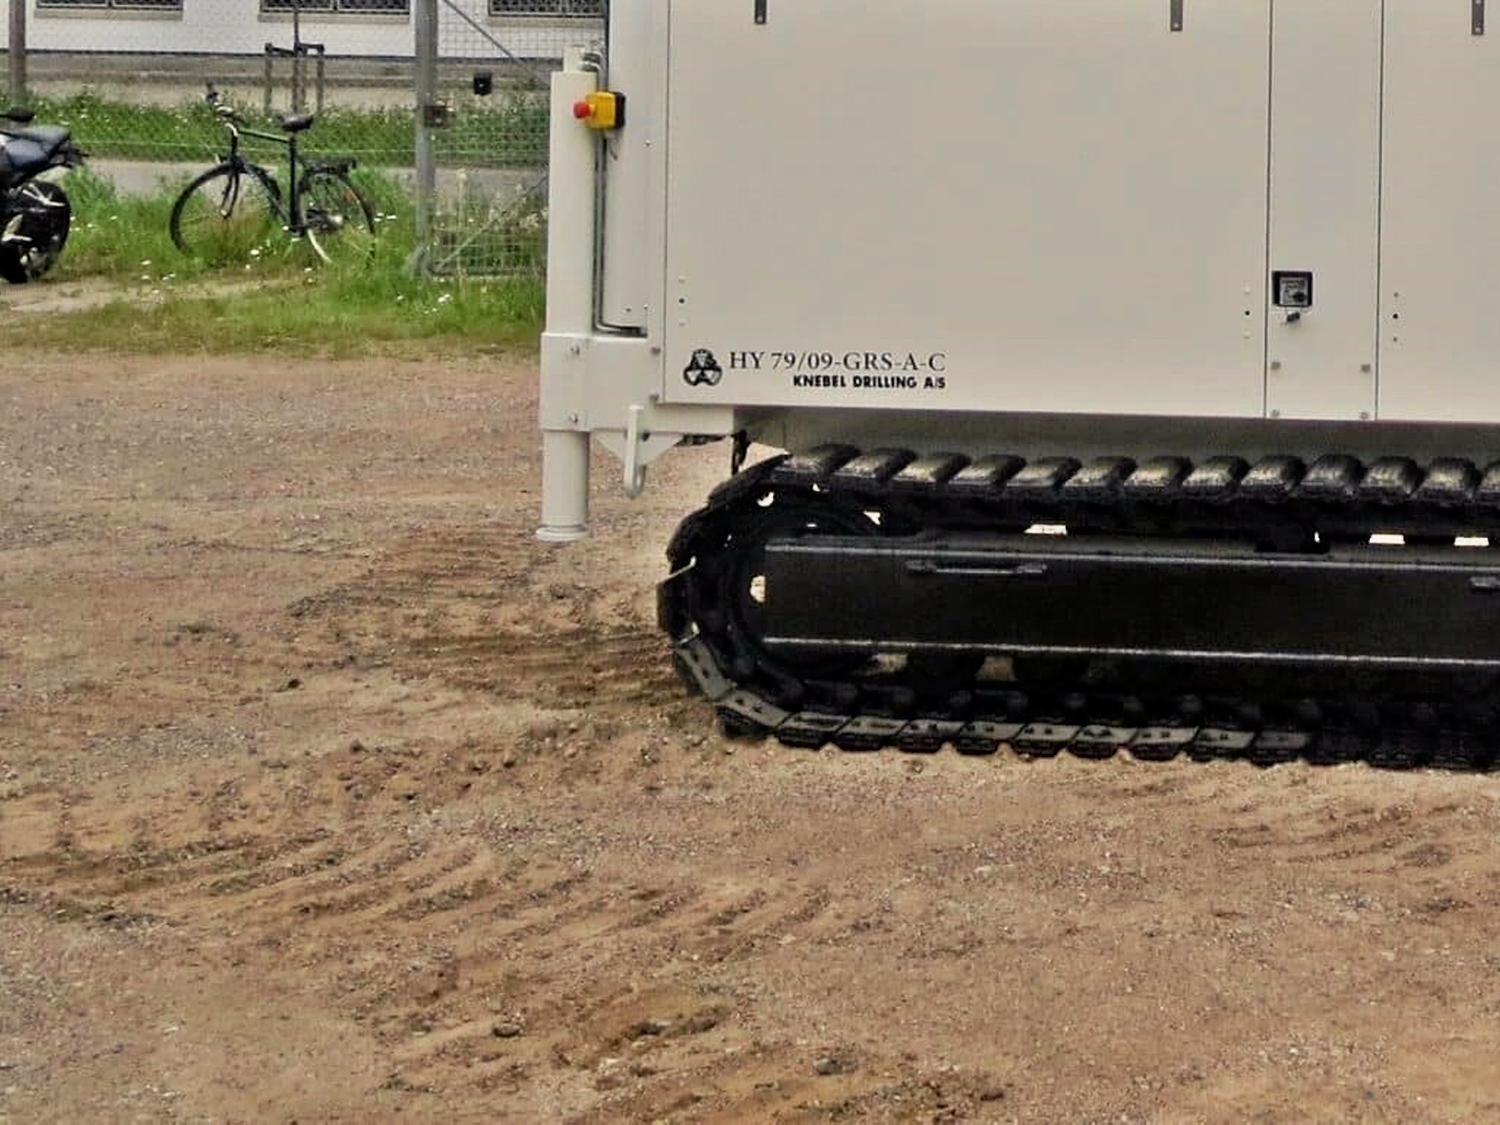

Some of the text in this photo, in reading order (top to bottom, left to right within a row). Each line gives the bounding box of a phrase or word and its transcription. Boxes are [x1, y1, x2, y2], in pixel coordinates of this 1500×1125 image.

[729, 351, 764, 369] HY
[793, 375, 946, 388] KNEBEL DRILLING A/S
